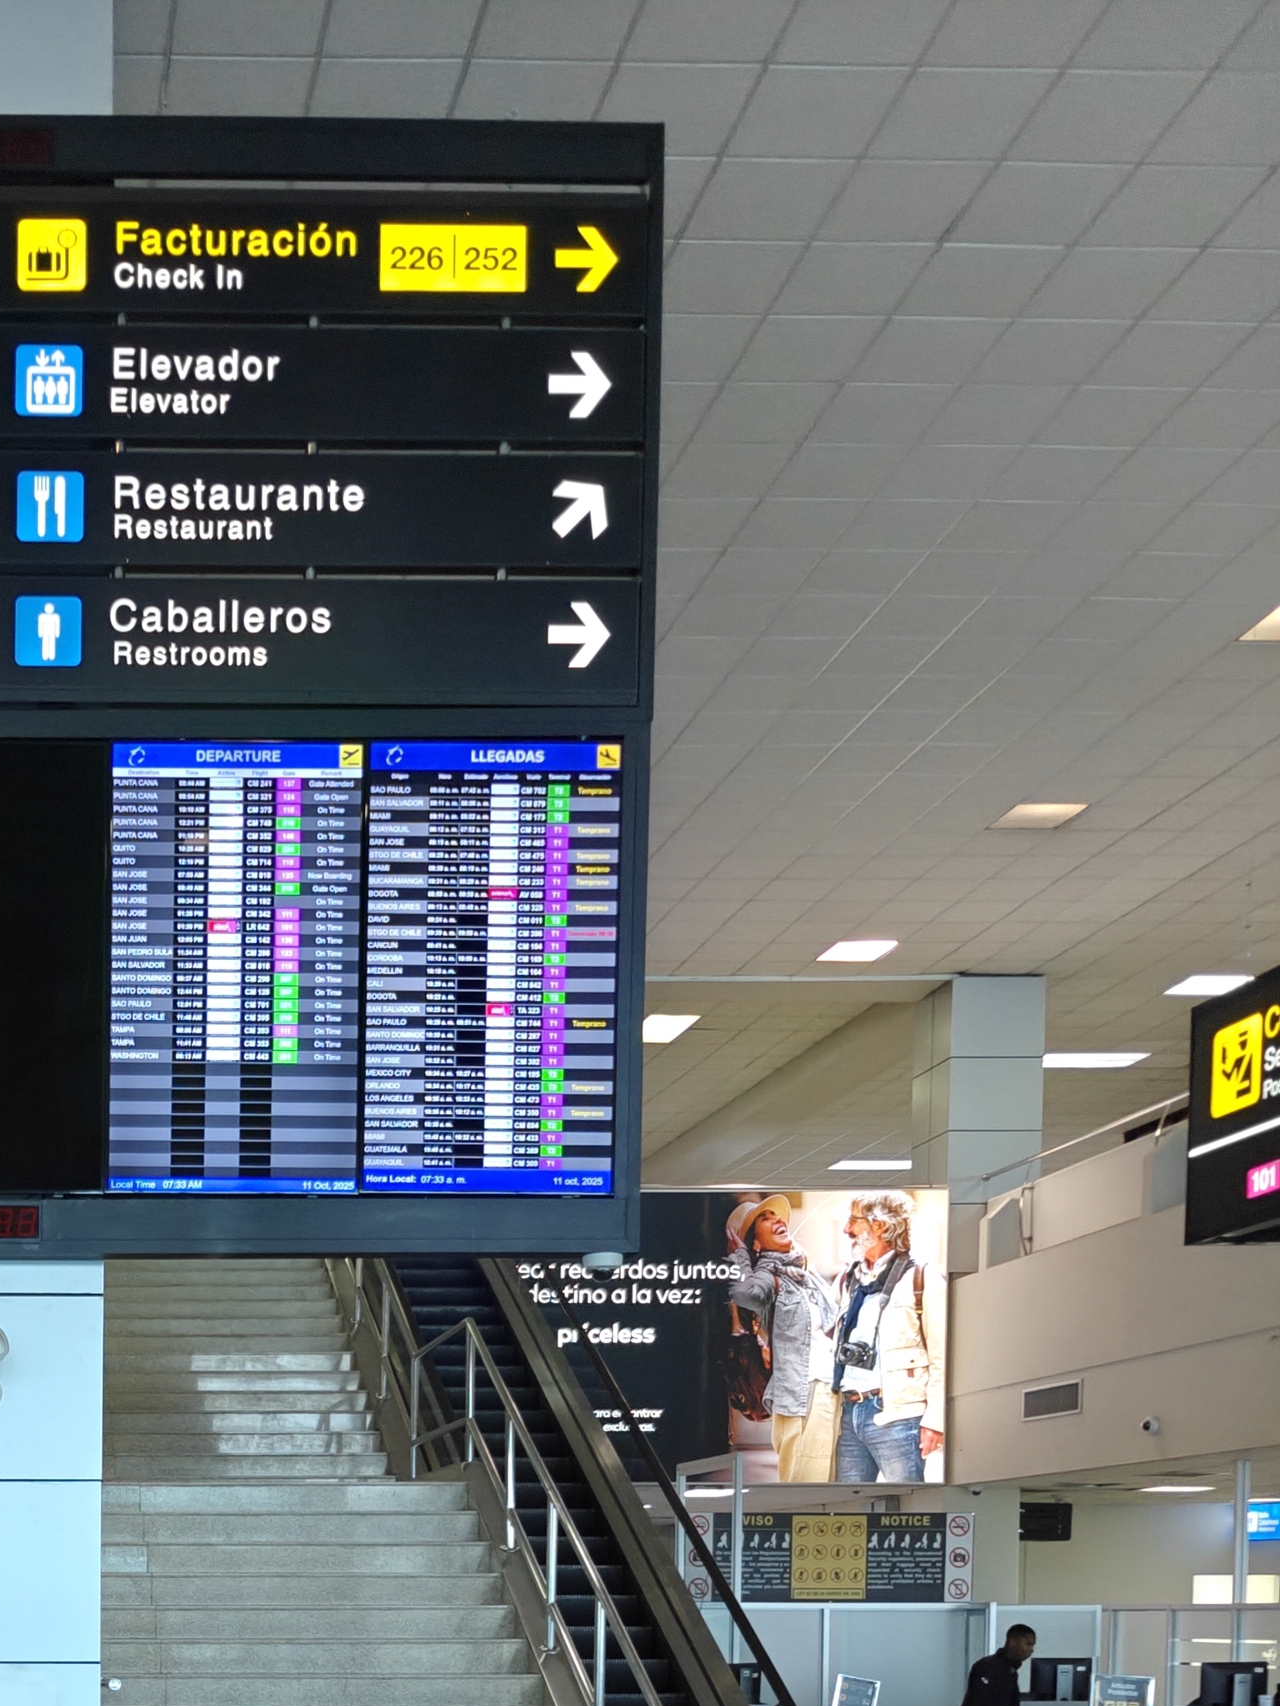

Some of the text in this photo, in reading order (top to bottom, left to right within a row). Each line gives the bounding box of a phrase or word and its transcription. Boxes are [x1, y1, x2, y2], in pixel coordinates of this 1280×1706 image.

[115, 222, 357, 258] Facturación
[390, 246, 517, 271] 226 252
[114, 264, 242, 290] Check In
[112, 347, 280, 382] Elevador
[110, 388, 229, 414] Elevator
[114, 476, 364, 511] Restaurante
[114, 516, 273, 541] Restaurant
[110, 598, 331, 634] Caballeros
[114, 641, 268, 667] Restrooms
[196, 750, 281, 762] DEPARTURE
[470, 750, 545, 763] LLEGADAS
[111, 1180, 202, 1189] Local Time 07:33 AM
[366, 1174, 388, 1184] Hora
[389, 1174, 417, 1184] Local:
[421, 1175, 443, 1184] 07:33
[1252, 1165, 1276, 1192] 101
[671, 1259, 746, 1284] juntos,
[611, 1288, 626, 1304] a
[632, 1283, 651, 1304] la
[655, 1288, 702, 1304] vez:
[742, 1515, 773, 1526] VISO
[881, 1515, 931, 1526] NOTICE
